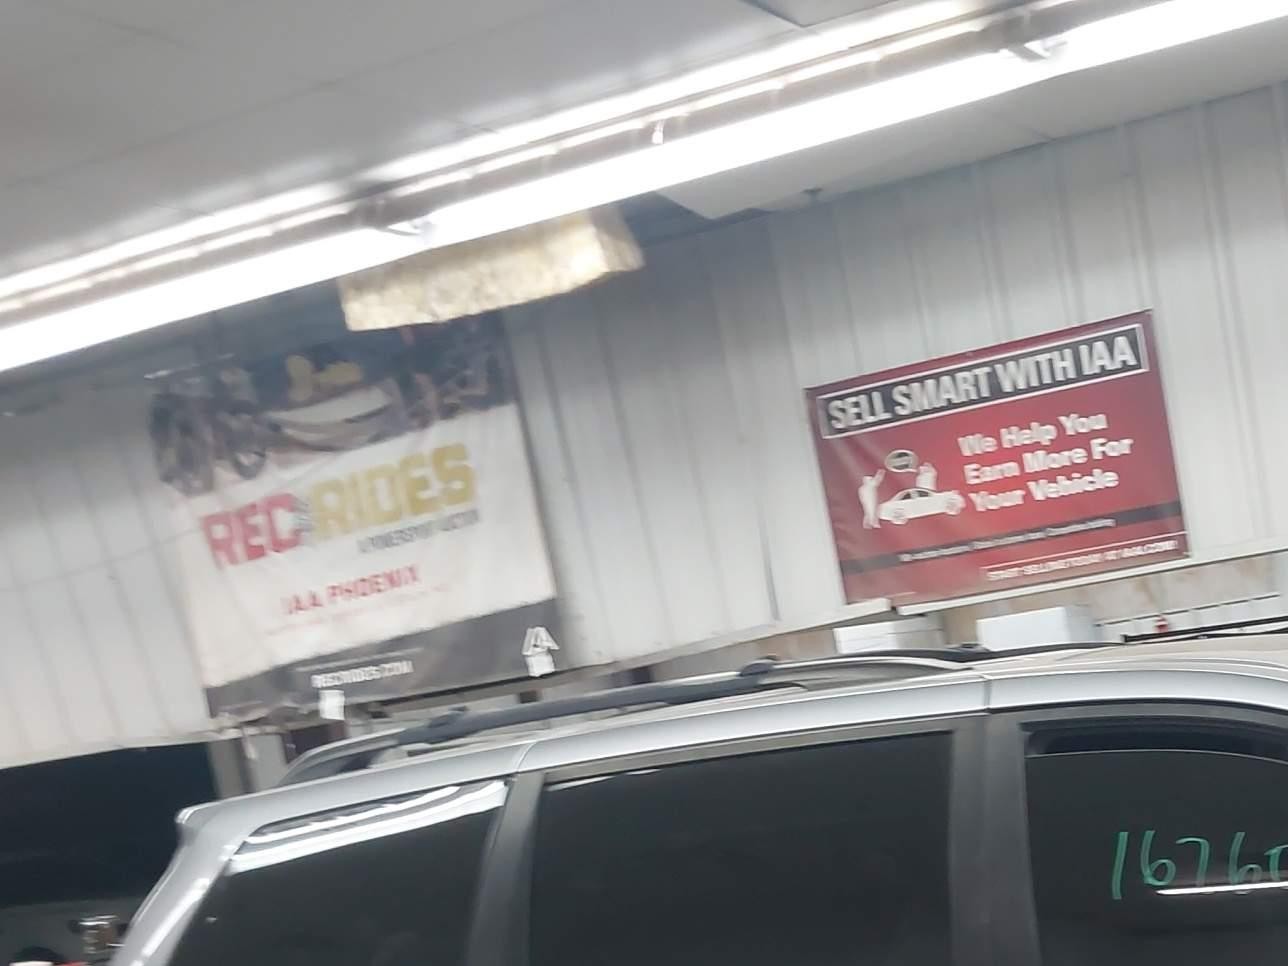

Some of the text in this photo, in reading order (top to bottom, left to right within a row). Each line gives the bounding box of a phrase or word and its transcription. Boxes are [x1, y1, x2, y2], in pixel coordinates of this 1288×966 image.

[828, 336, 1138, 430] SELL SMART WITH IAA
[957, 413, 1108, 457] We Help You
[964, 437, 1134, 485] Earn More For
[201, 491, 303, 570] REC
[309, 442, 478, 540] RIDES
[968, 469, 1119, 512] Your Vehicle
